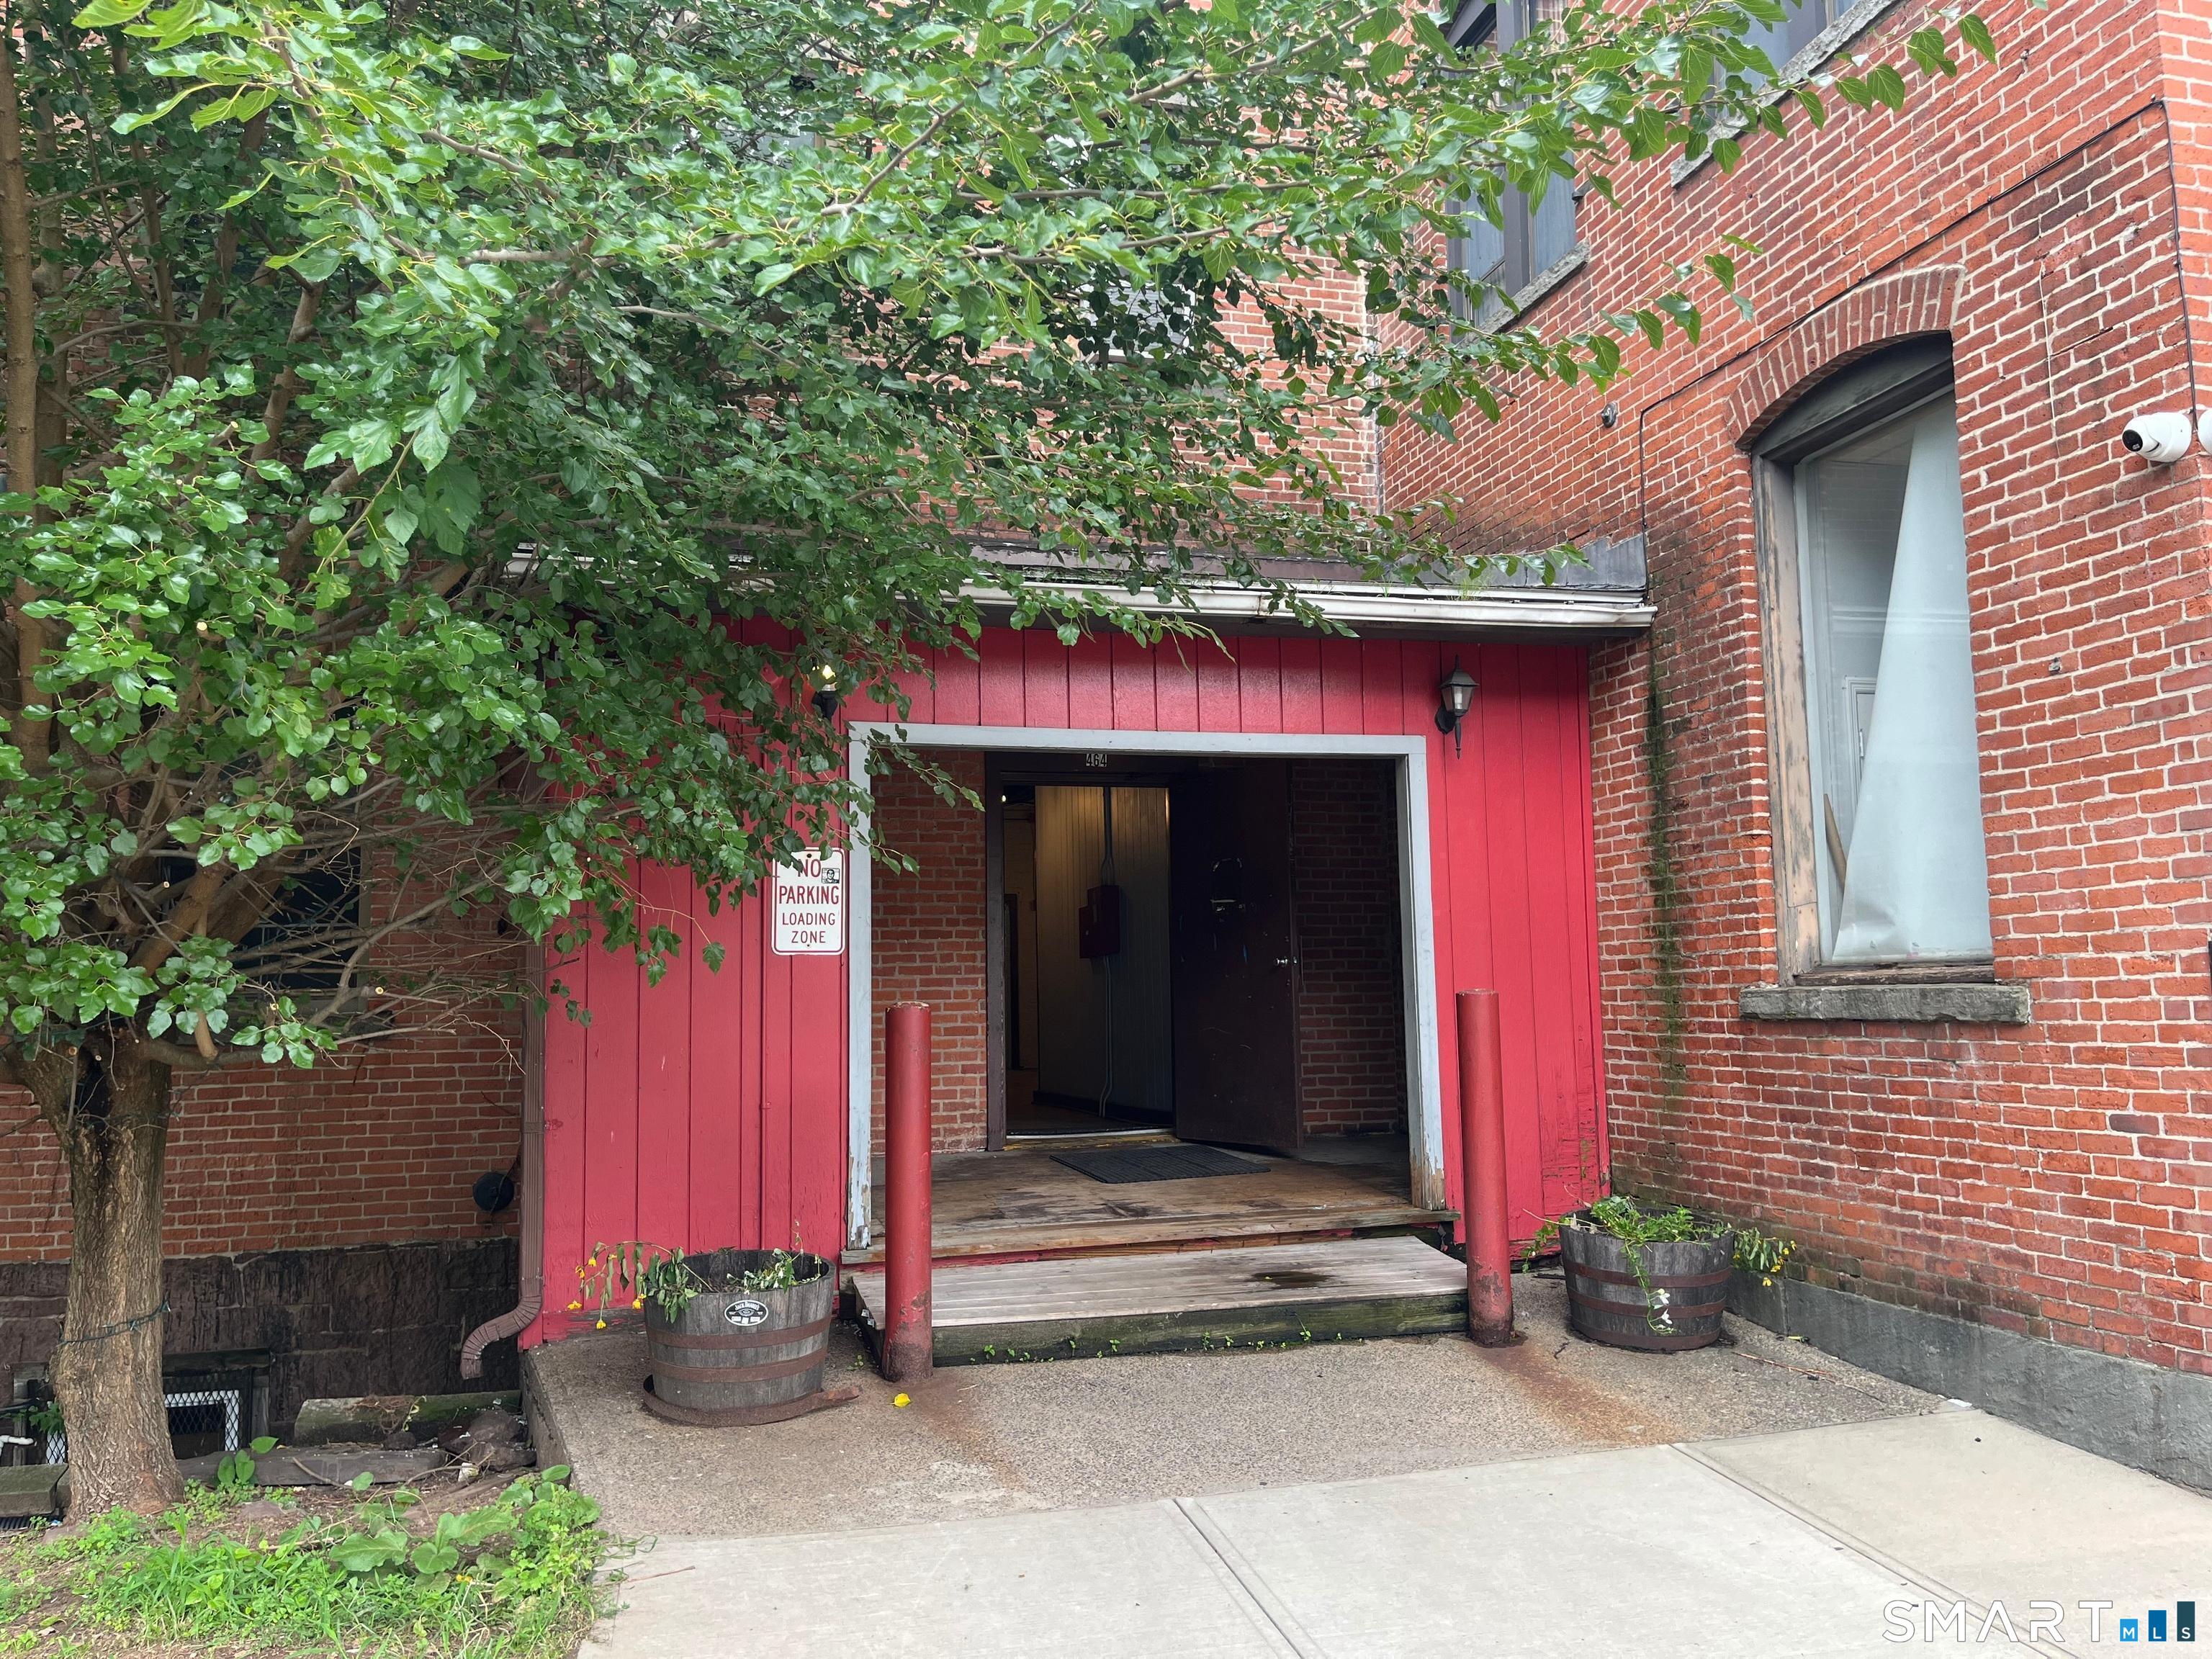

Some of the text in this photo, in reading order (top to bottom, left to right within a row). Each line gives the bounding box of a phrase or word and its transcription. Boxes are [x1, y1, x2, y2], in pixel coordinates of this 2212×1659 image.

[1087, 754, 1107, 767] 464
[798, 858, 822, 878] NO
[778, 886, 840, 904] PARKING
[782, 912, 836, 925] LOADING
[791, 930, 826, 943] ZONE
